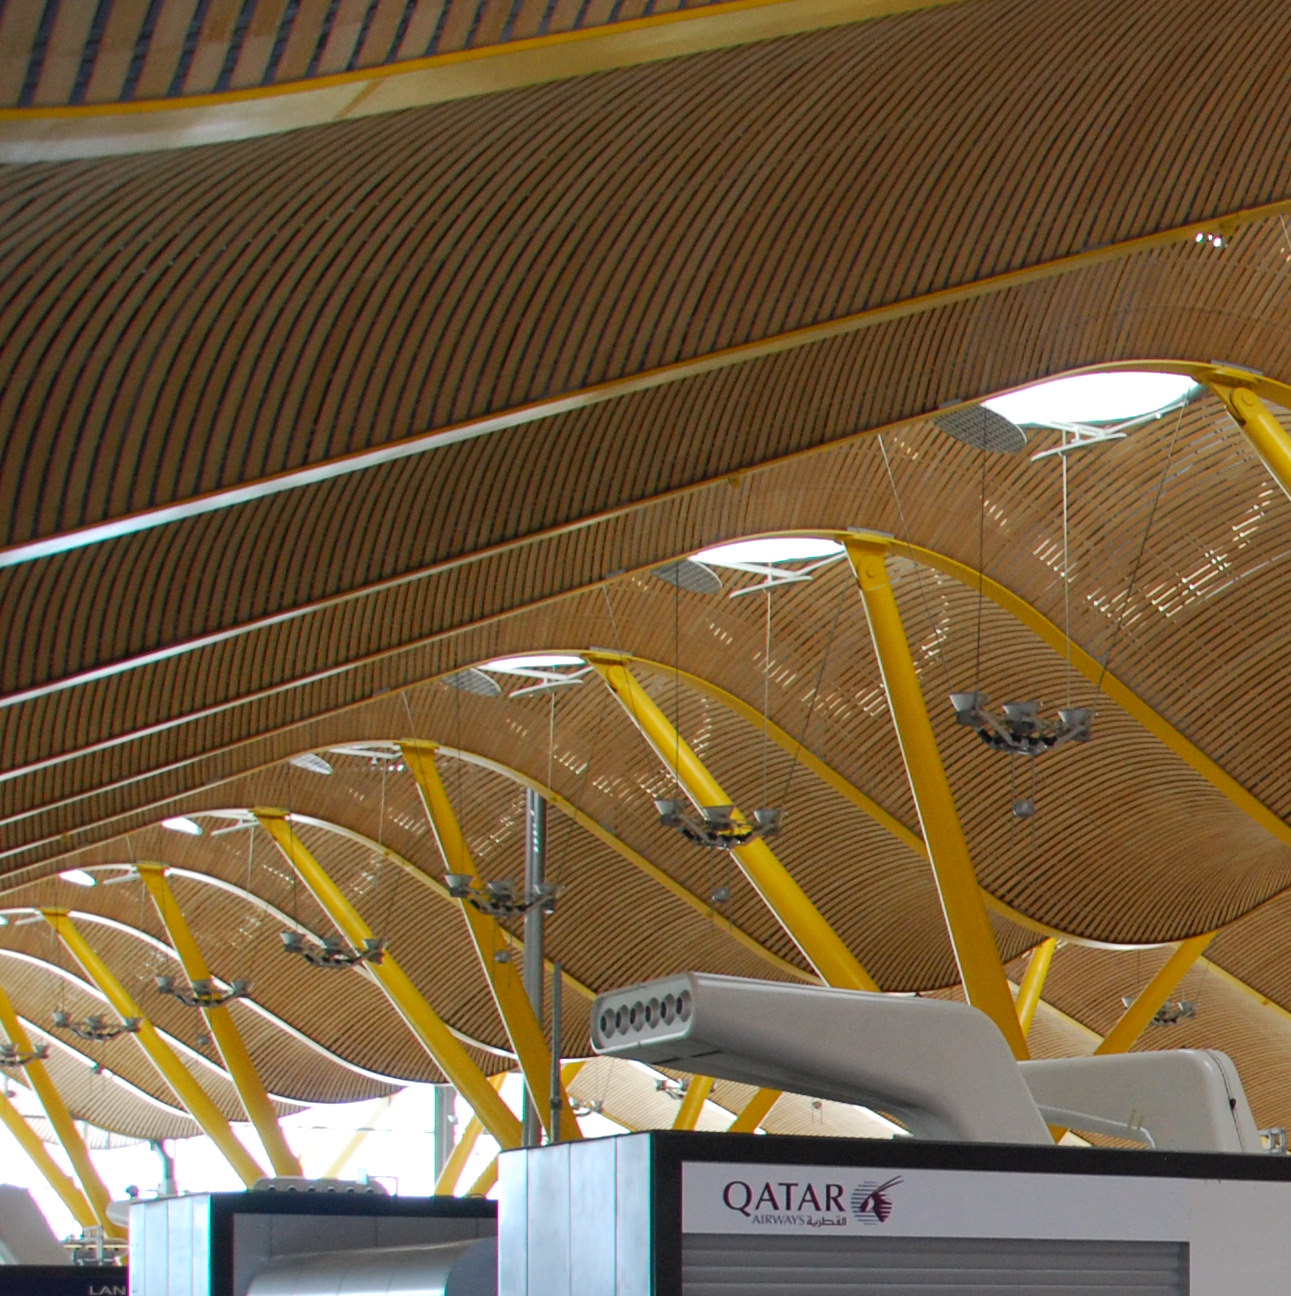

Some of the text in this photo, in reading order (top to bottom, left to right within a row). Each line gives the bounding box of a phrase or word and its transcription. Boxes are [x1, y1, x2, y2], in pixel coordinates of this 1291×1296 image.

[722, 1180, 846, 1218] QATAR
[751, 1214, 805, 1226] AIRWAYS
[806, 1215, 848, 1228] القطرية
[88, 1284, 126, 1296] LAN
